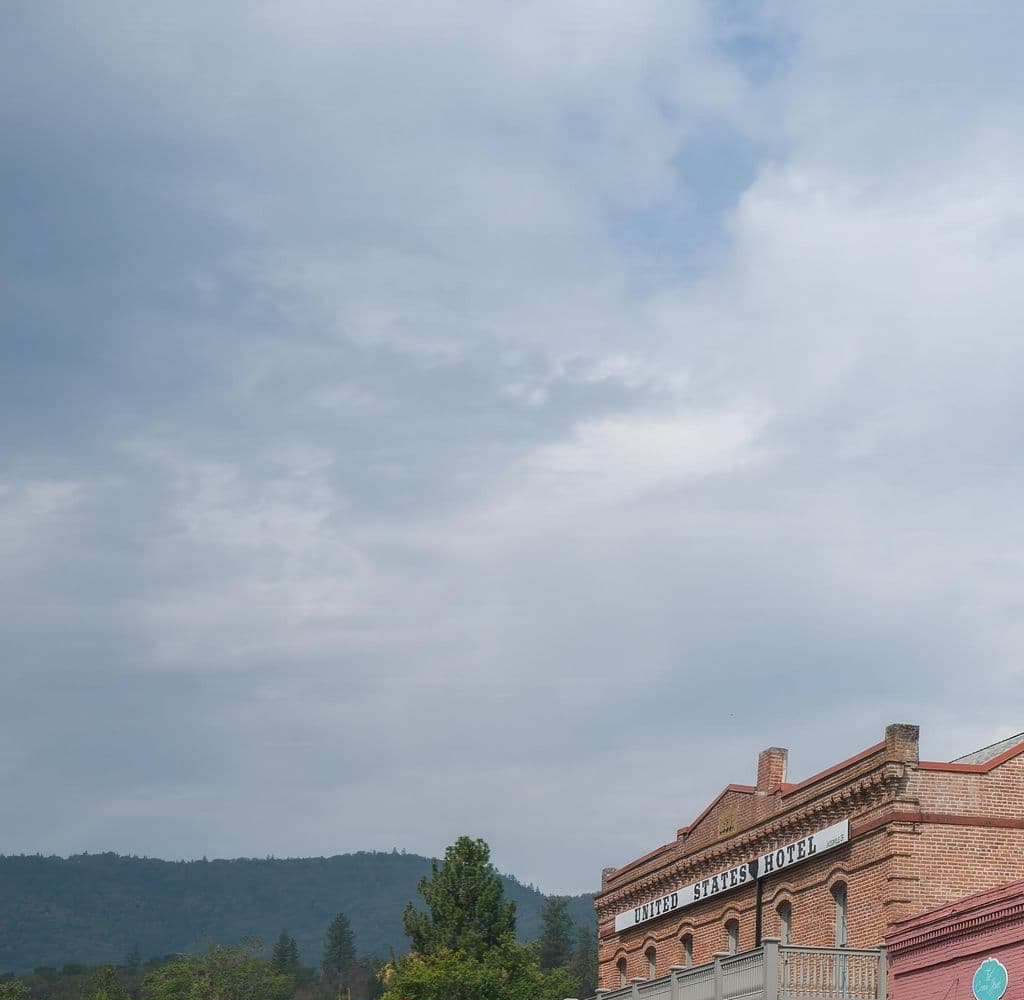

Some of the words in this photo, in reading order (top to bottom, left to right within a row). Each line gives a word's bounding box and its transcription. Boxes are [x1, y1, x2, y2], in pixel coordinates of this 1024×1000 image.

[634, 893, 679, 924] UNITED
[693, 864, 748, 900] STATES
[764, 836, 817, 873] HOTEL
